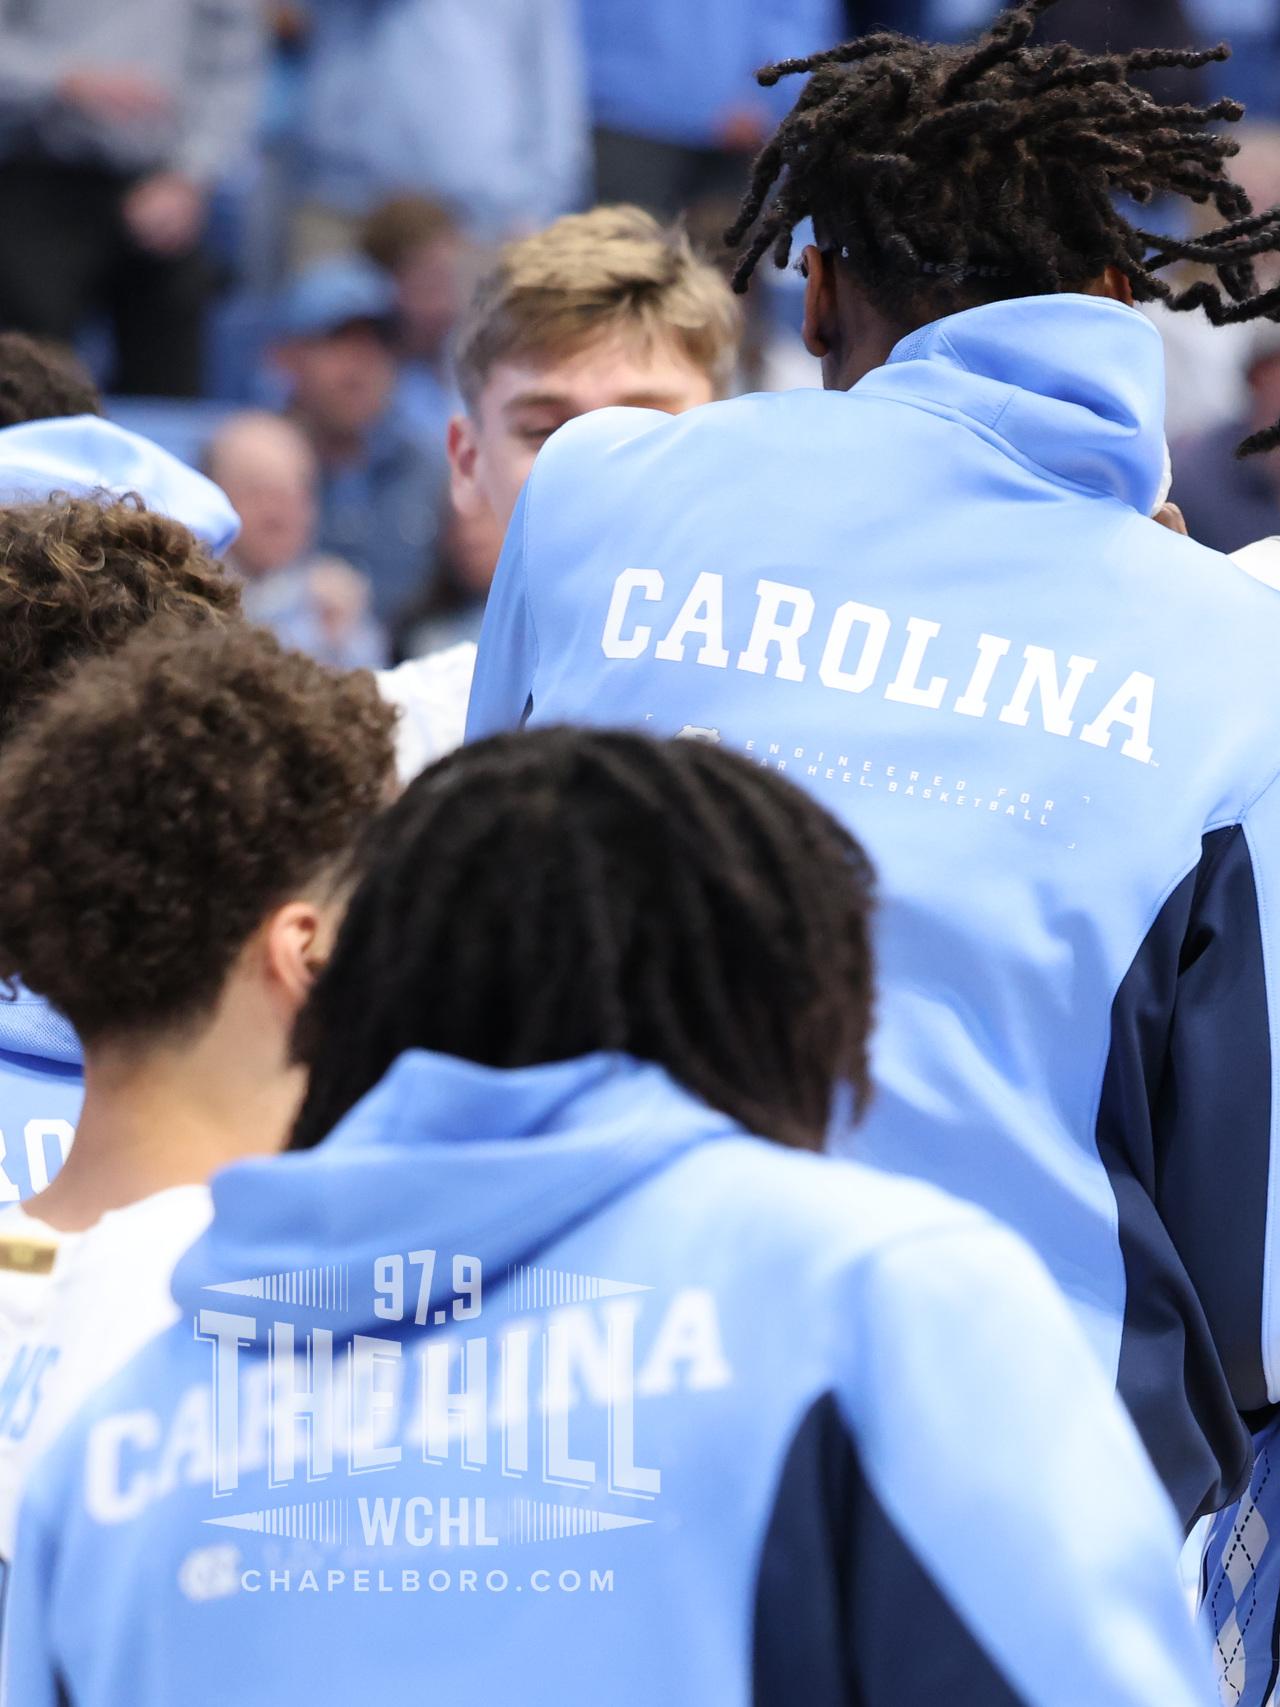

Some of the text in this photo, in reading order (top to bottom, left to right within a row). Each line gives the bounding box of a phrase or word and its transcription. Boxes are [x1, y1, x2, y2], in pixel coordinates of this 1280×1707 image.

[600, 567, 1156, 764] CAROLINA
[744, 739, 1054, 811] ENGINEERED FOR
[745, 755, 787, 772] AR
[887, 781, 1048, 826] BASKETBALL
